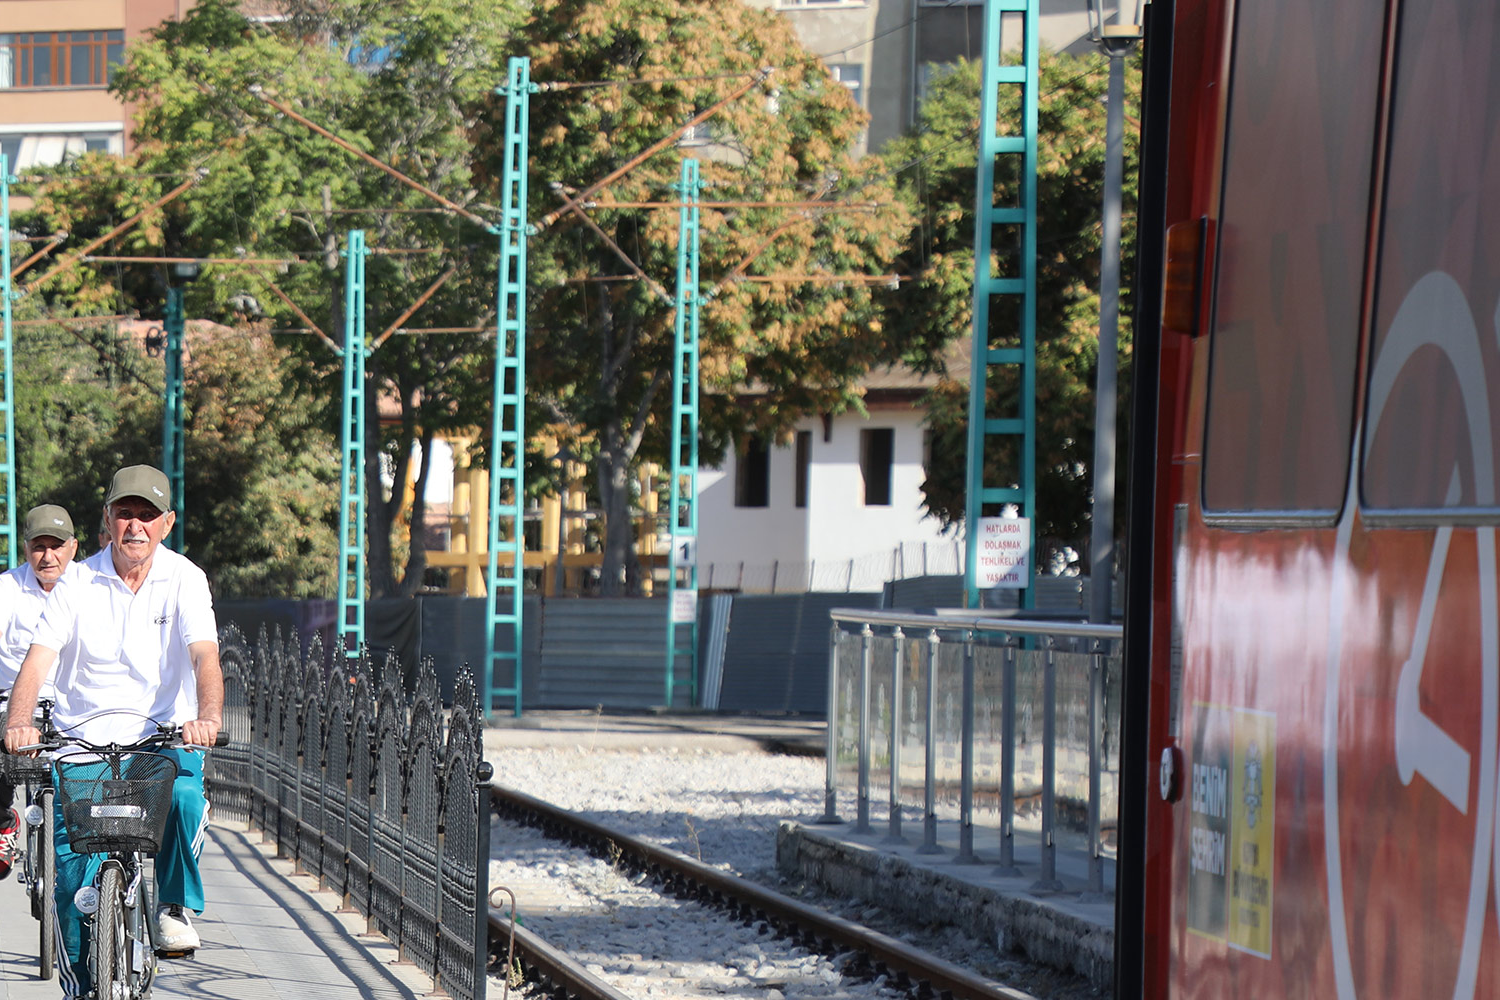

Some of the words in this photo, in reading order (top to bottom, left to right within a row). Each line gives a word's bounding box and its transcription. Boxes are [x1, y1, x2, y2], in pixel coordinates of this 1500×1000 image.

[986, 524, 1021, 533] HATLARDA
[985, 541, 1021, 551] DOLAŞMAK
[680, 542, 690, 560] 1
[1016, 557, 1025, 566] VE
[986, 573, 1019, 582] YASAKTIR
